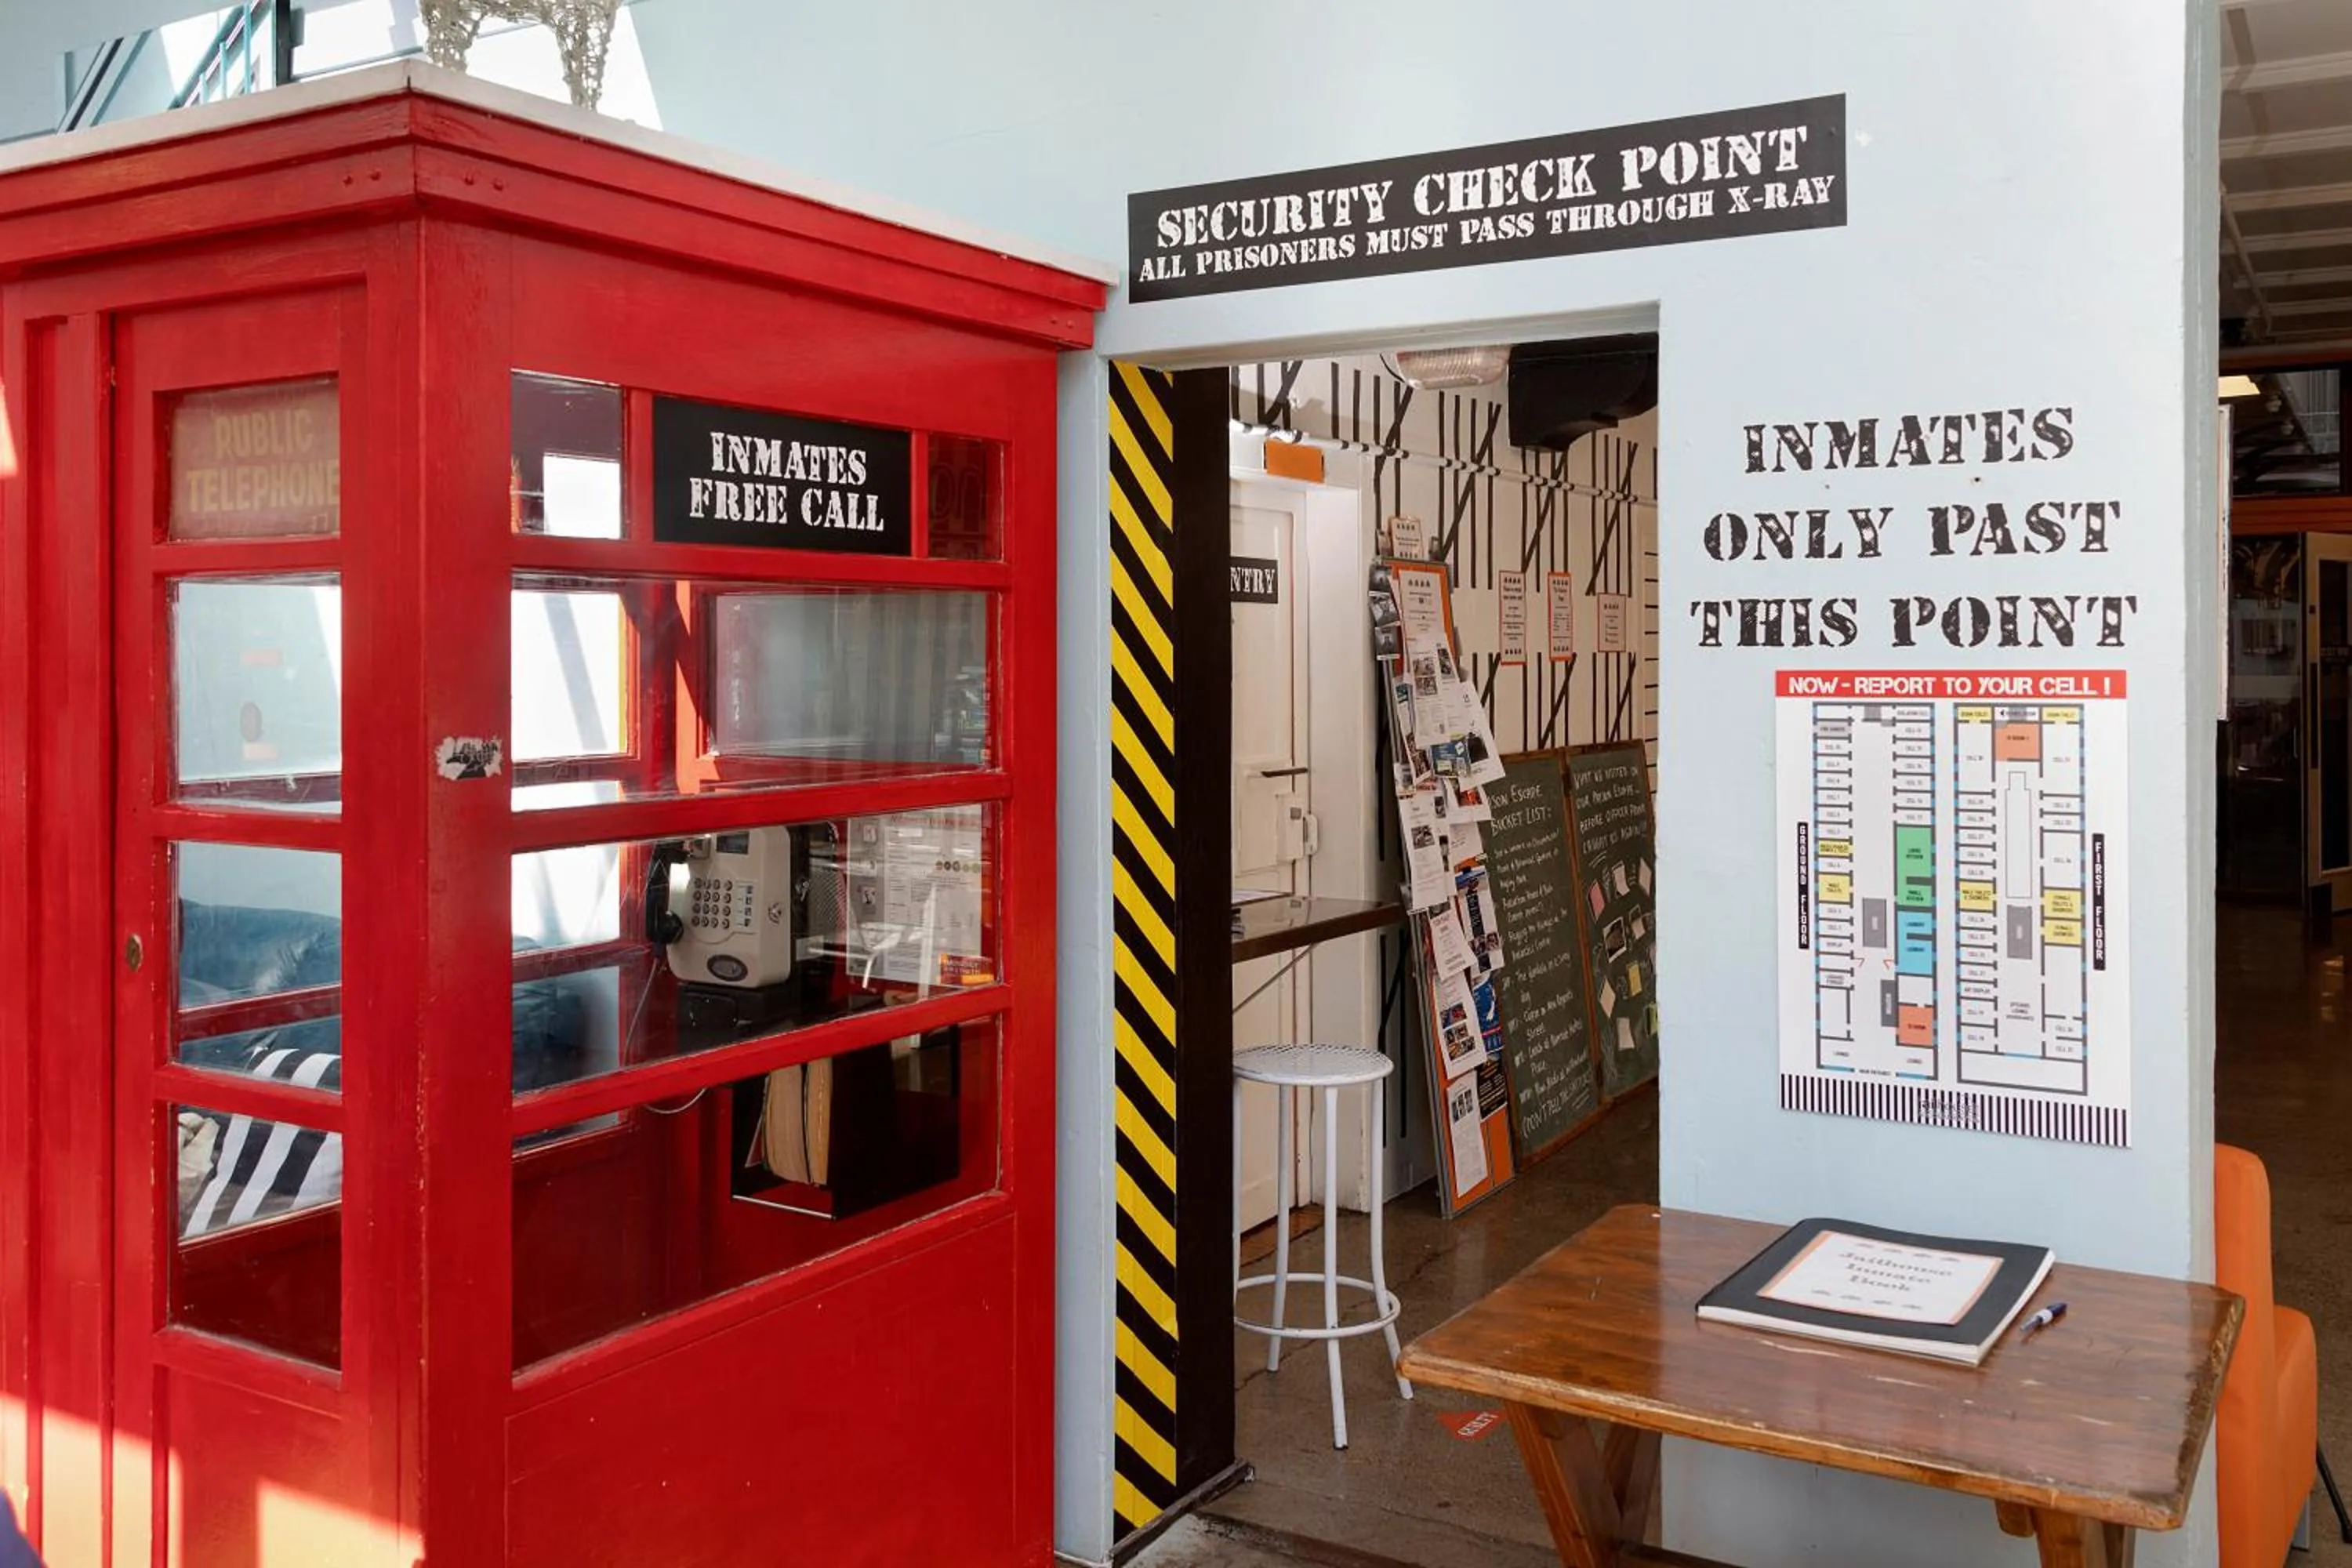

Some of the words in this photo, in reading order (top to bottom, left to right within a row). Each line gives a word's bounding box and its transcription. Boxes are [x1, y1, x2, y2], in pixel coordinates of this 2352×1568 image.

[1156, 180, 1394, 249] SECURITY
[1413, 153, 1598, 216] CHECK
[1620, 125, 1808, 191] POINT
[1138, 254, 1186, 283] ALL
[1196, 234, 1356, 276] PRISONERS
[1366, 222, 1448, 256] MUST
[1459, 212, 1534, 245] PASS
[1545, 189, 1715, 234] THROUGH
[1727, 174, 1836, 214] X-RAY
[214, 408, 314, 459] PUBLIC
[710, 431, 866, 485] INMATES
[1743, 407, 2074, 474] INMATES
[187, 459, 339, 512] TELEPHONE
[689, 477, 788, 524] FREE
[800, 488, 884, 532] CALL
[1703, 507, 1894, 561] ONLY
[1927, 501, 2122, 557] PAST
[1230, 566, 1276, 594] NTRY
[1690, 597, 1859, 648] THIS
[1889, 595, 2138, 648] POINT
[1788, 676, 1840, 695] NOW
[1853, 676, 1937, 695] REPORT
[1942, 676, 1973, 695] TO
[1977, 676, 2034, 696] YOUR
[2038, 676, 2099, 696] CELL
[2094, 841, 2103, 896] FIRST
[2095, 906, 2104, 960] FLOOR
